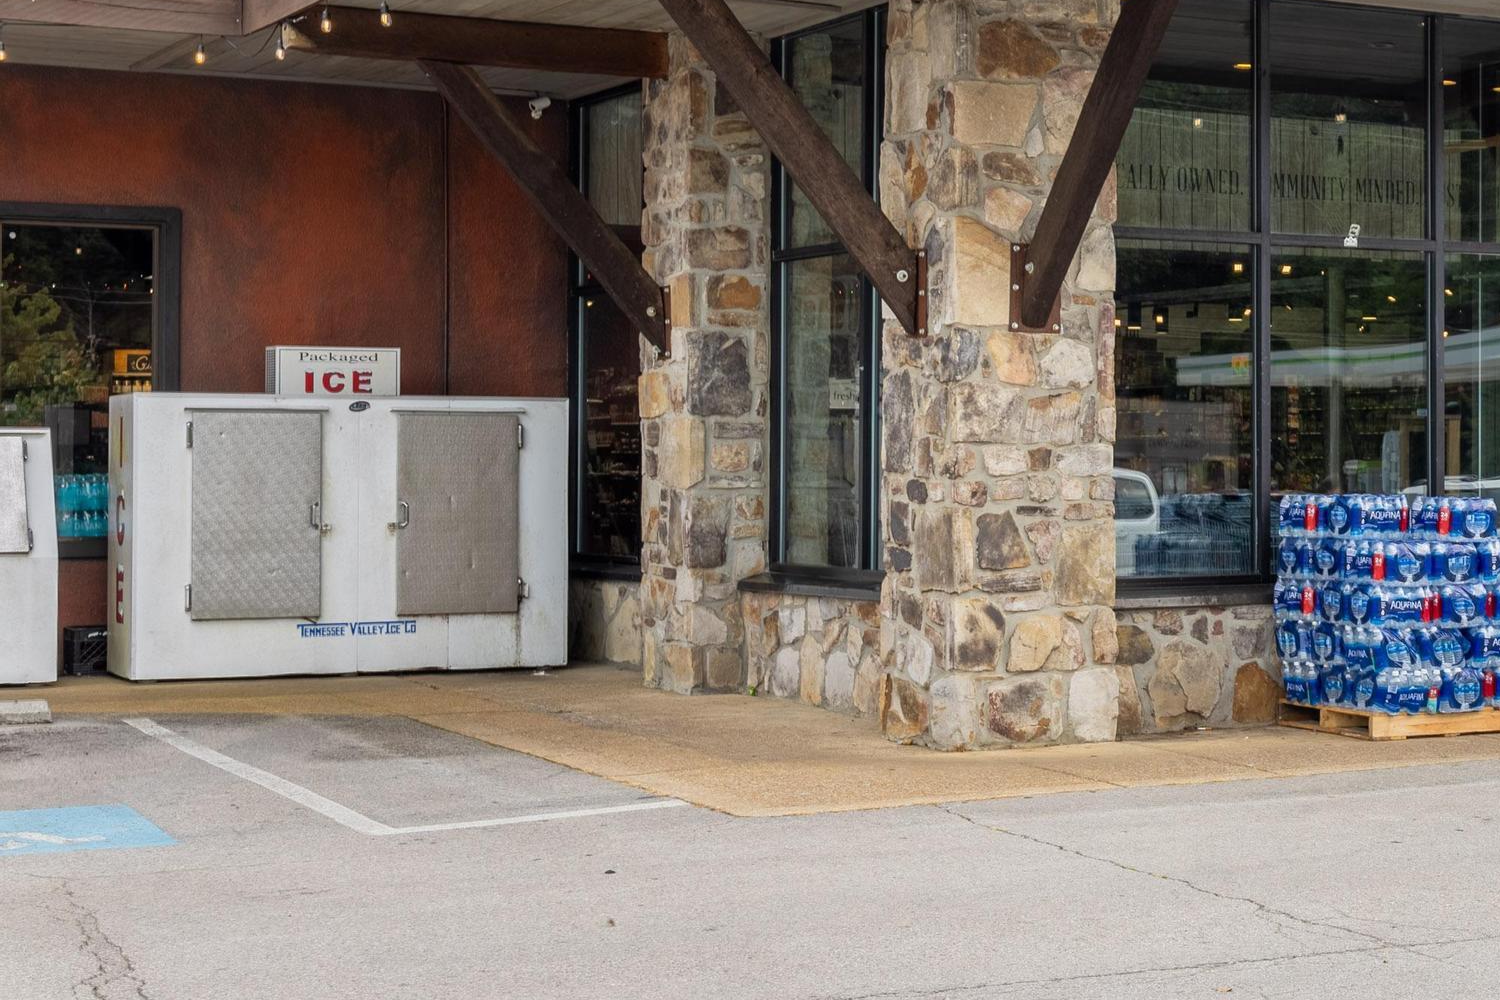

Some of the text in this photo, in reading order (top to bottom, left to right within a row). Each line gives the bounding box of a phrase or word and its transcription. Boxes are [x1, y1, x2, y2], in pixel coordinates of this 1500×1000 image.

[299, 351, 379, 364] Packaged
[305, 370, 373, 394] ICE
[297, 623, 348, 638] TENNESSEE
[350, 621, 384, 636] VALLEY
